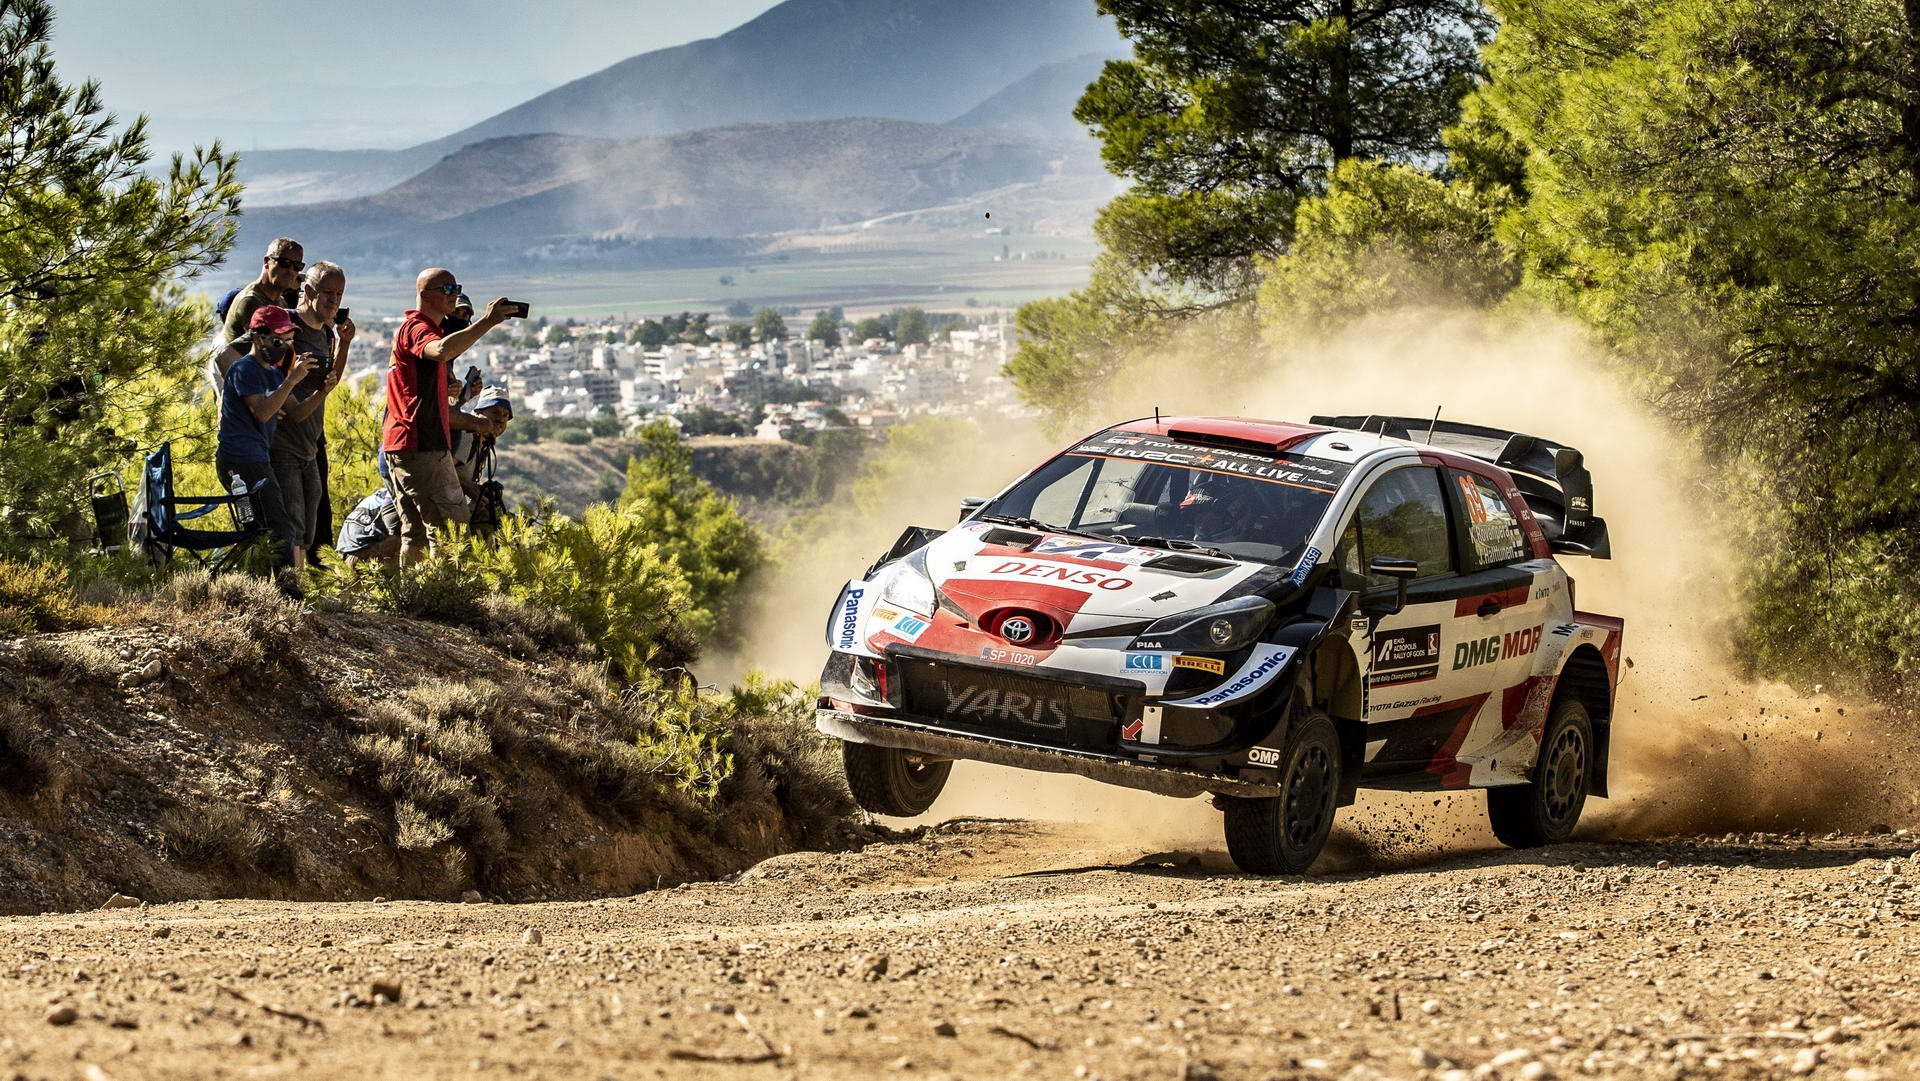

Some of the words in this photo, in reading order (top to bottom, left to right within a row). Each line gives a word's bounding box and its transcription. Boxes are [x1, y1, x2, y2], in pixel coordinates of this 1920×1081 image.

[1145, 441, 1209, 452] TOYOTA
[1212, 449, 1273, 463] GAZOO
[1275, 459, 1334, 475] Racing
[1211, 460, 1250, 473] ALL
[1255, 466, 1303, 482] LIVE
[990, 562, 1133, 590] DENSO
[840, 589, 865, 649] Panasonic
[990, 649, 1006, 661] SP
[1010, 652, 1035, 666] 1020
[1393, 643, 1417, 652] ACROPOLIS
[1393, 651, 1406, 660] RALLY
[1452, 635, 1501, 671] DMG
[1175, 656, 1222, 672] PIRELLI
[1195, 651, 1287, 706] Panasonic
[942, 680, 1067, 729] YARIS
[1393, 700, 1419, 709] GAZOO
[1419, 695, 1442, 705] Racing
[1249, 749, 1279, 764] OMP
